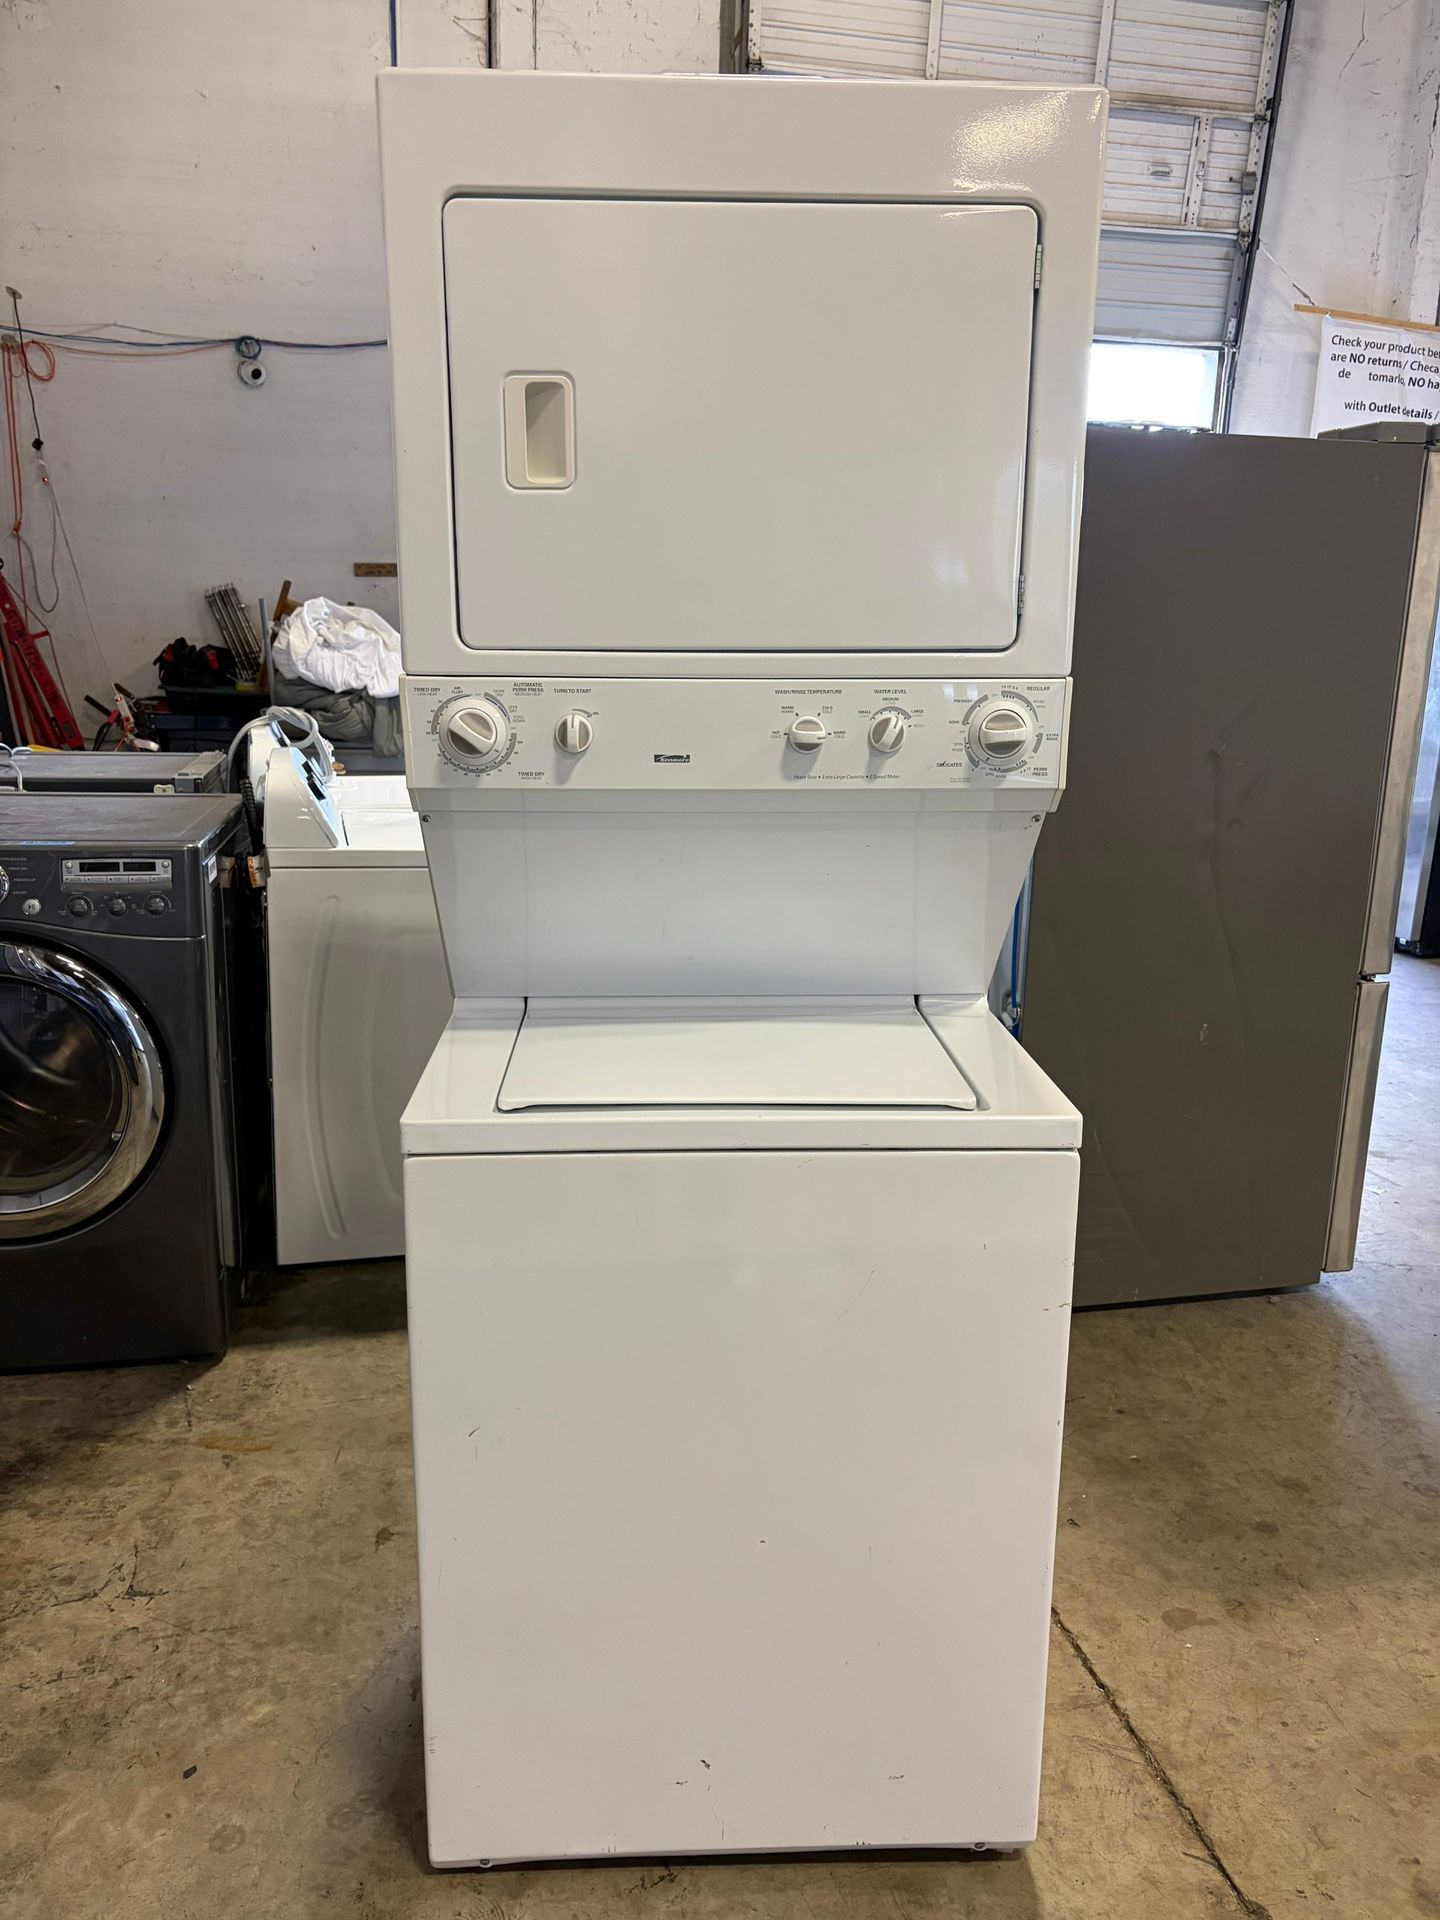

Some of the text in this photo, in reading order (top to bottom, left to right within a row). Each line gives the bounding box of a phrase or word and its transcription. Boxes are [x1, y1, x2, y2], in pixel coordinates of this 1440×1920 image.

[1332, 334, 1362, 347] Check
[1364, 340, 1386, 350] your
[1388, 343, 1426, 356] product
[1330, 353, 1347, 362] are
[1350, 353, 1365, 364] NO
[1410, 360, 1439, 373] Checa
[1338, 368, 1440, 392] de tomarlo, NO ha
[1344, 400, 1366, 411] with
[1369, 402, 1400, 414] Outlet
[1402, 407, 1433, 419] details
